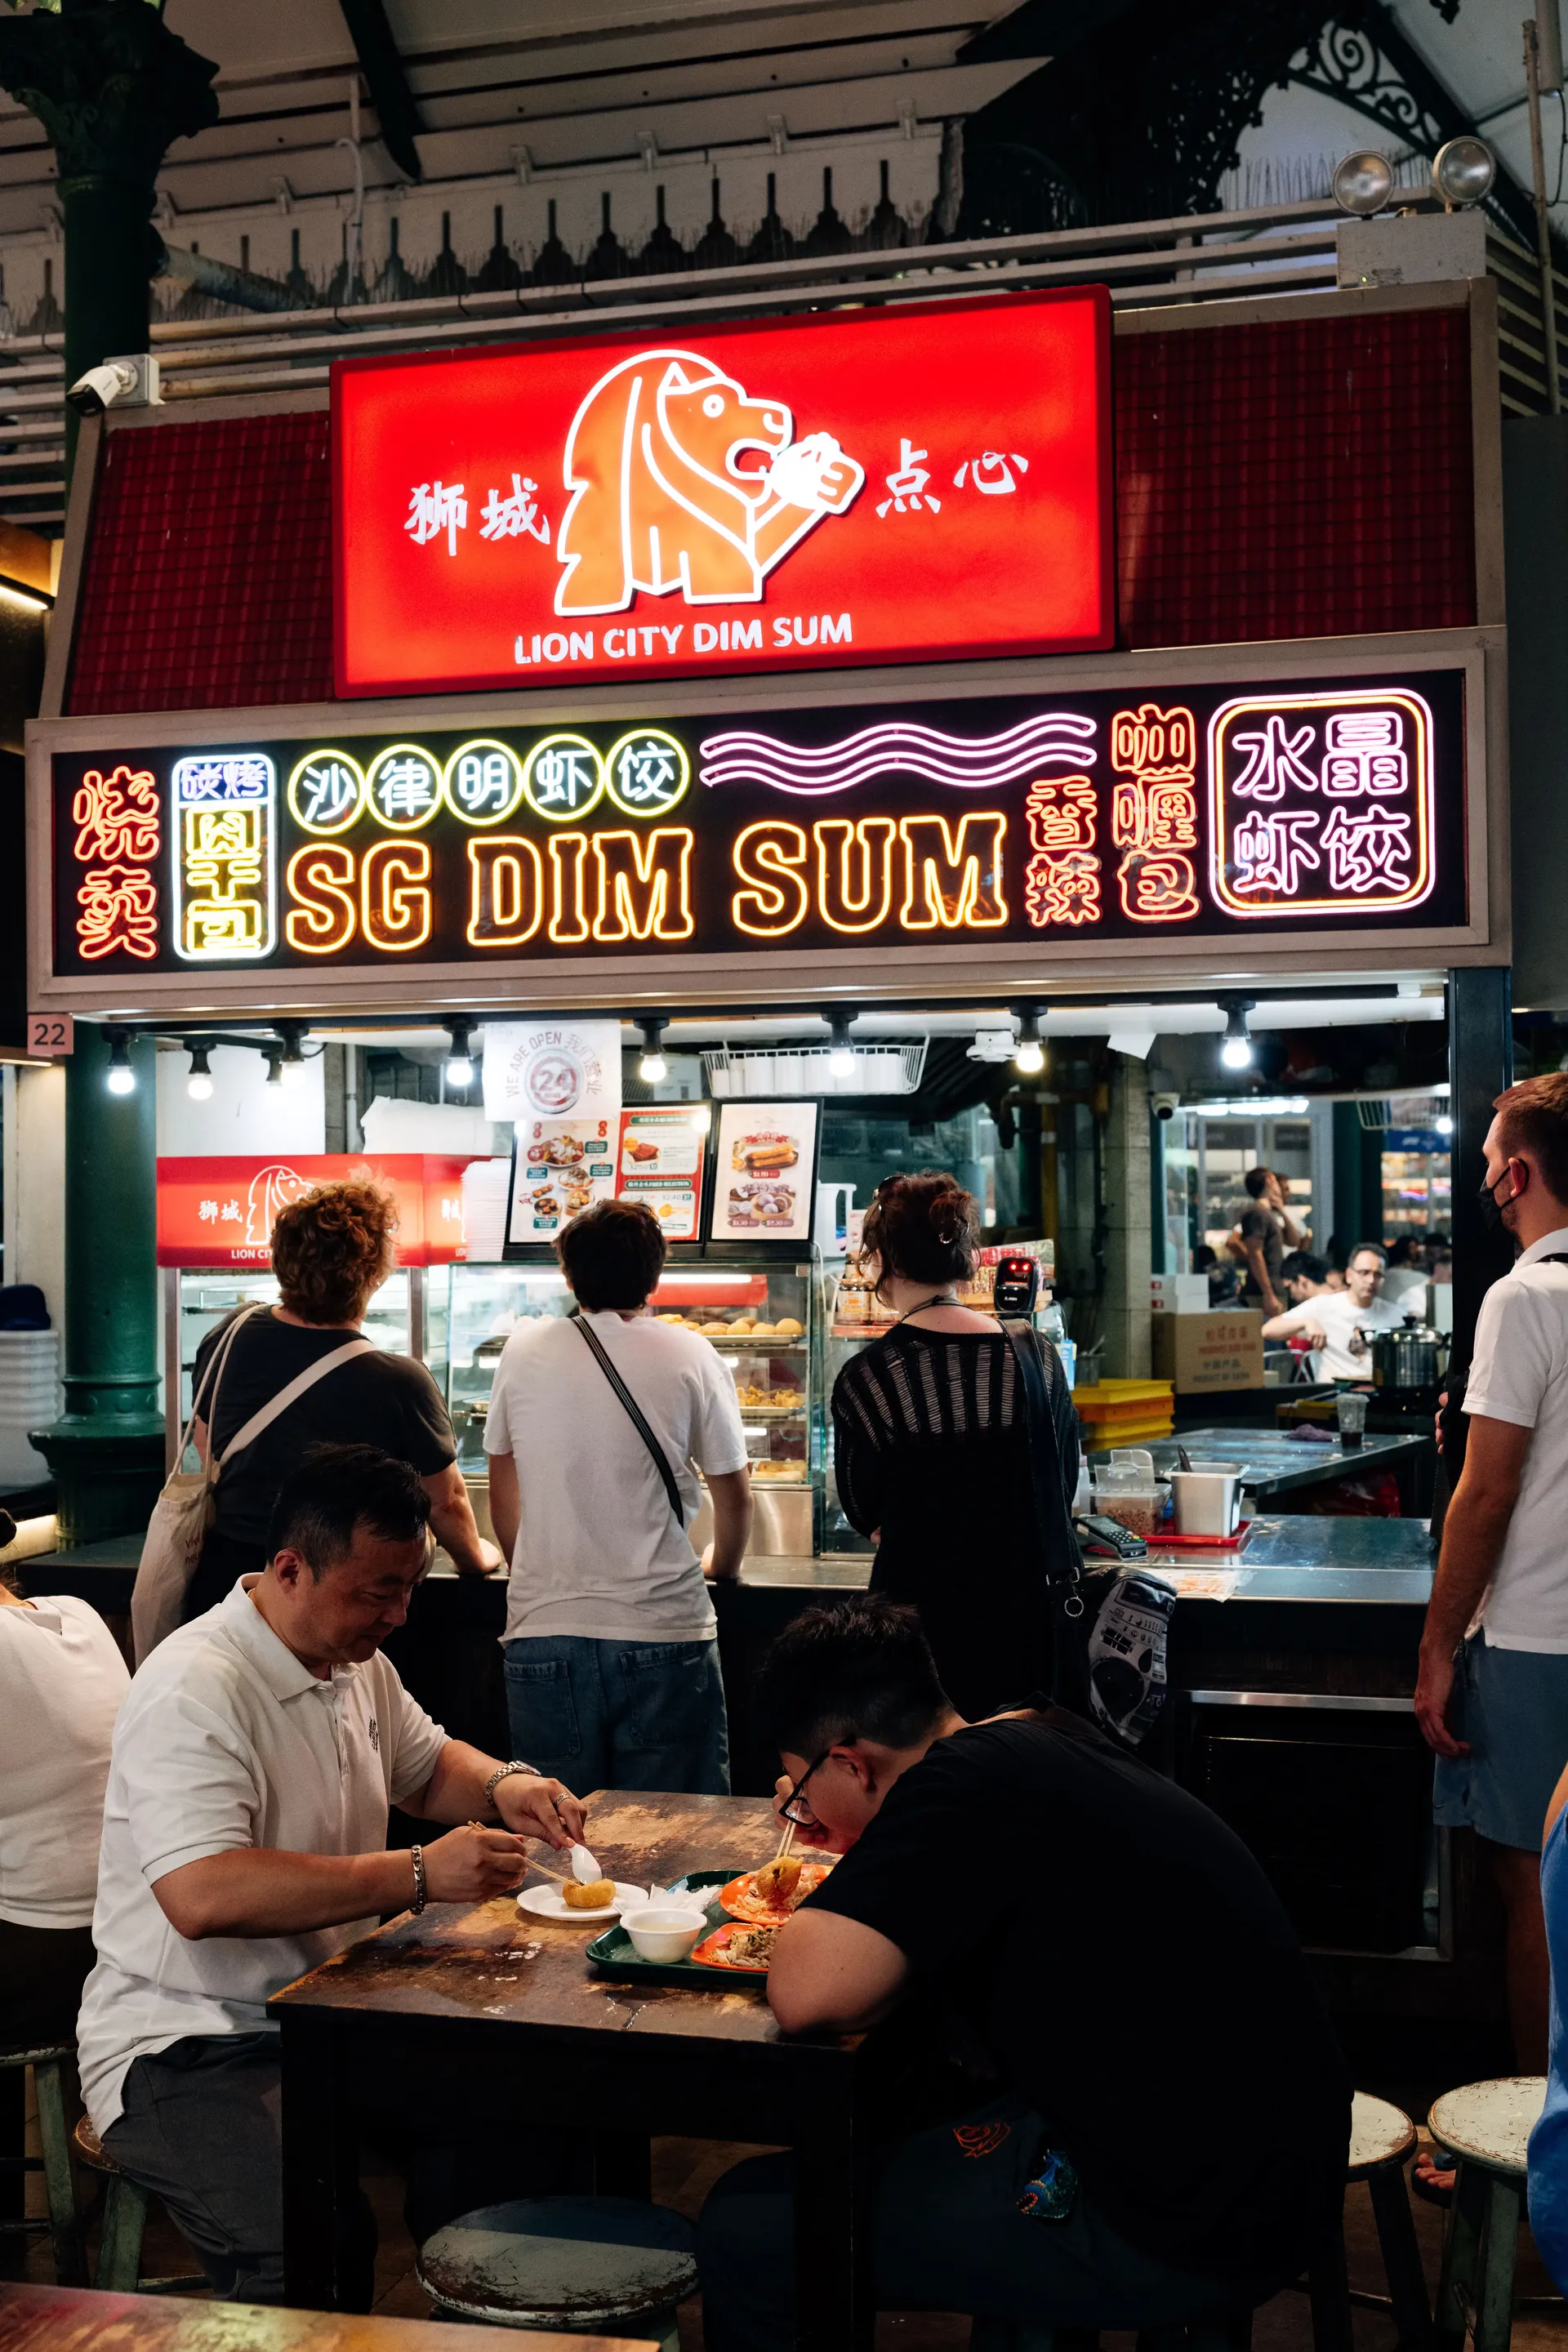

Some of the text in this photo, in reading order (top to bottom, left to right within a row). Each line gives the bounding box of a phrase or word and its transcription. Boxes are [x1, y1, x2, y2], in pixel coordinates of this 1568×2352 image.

[404, 439, 1029, 556] 狮城 点心
[514, 613, 853, 664] LION CITY DIM SUM
[180, 761, 267, 800] 碳烤
[303, 741, 676, 822] 沙律明虾饺
[1232, 710, 1410, 800] 水晶
[73, 765, 159, 960] 烧卖
[286, 811, 1009, 954] SG DIM SUM
[1232, 804, 1412, 895] 虾饺
[34, 1023, 65, 1045] 22
[506, 1032, 563, 1098] WE ARE OPEN
[231, 1249, 274, 1259] LION CIT
